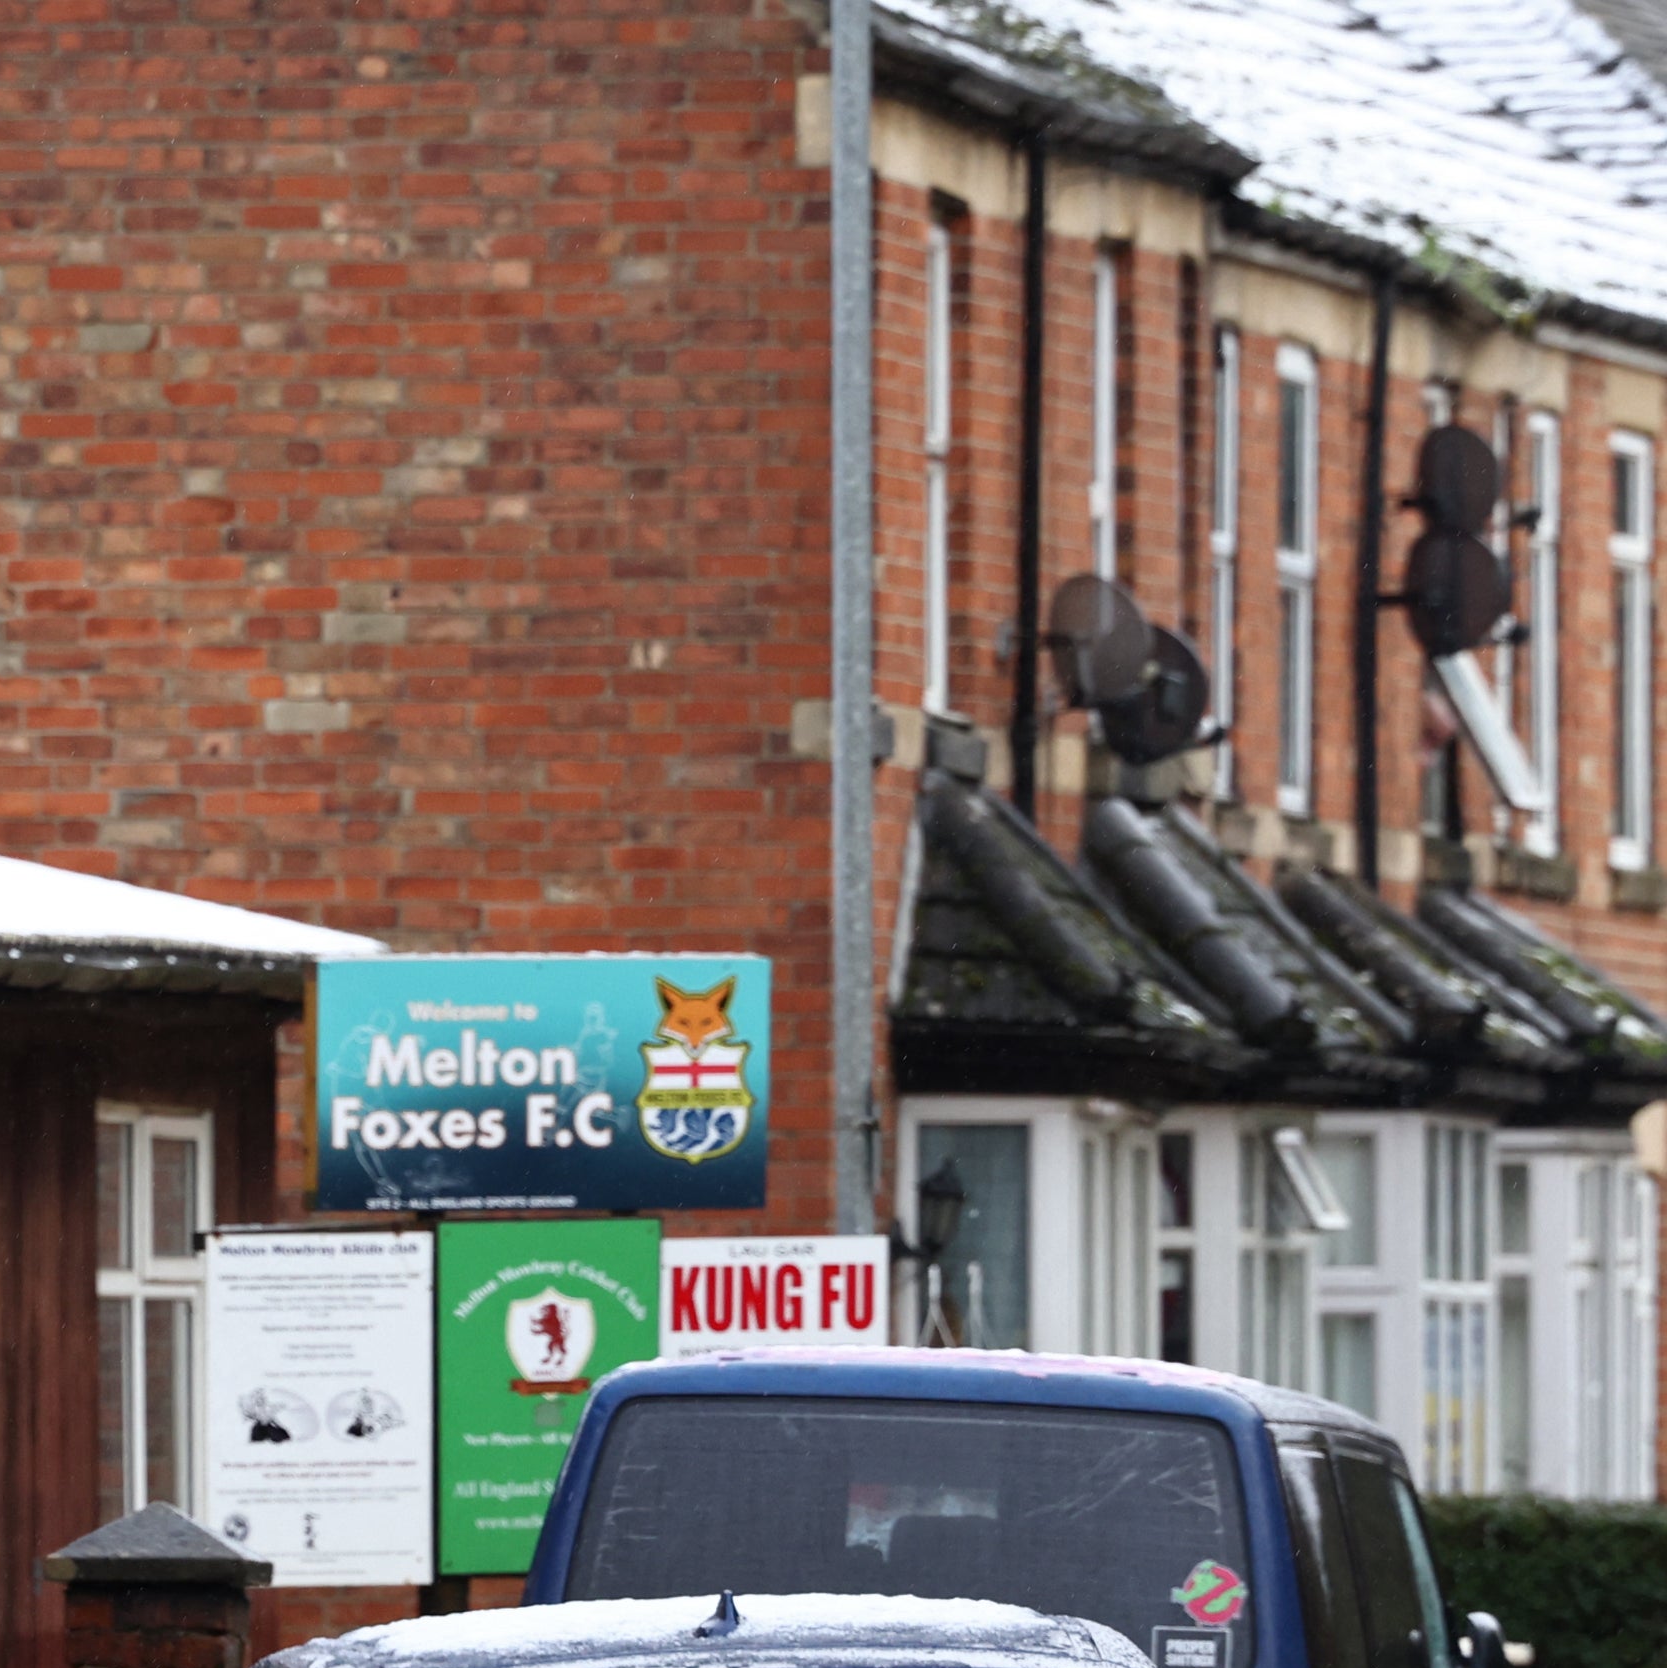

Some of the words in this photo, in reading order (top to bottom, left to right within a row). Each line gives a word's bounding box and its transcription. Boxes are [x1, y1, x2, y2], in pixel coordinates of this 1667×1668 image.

[407, 999, 509, 1022] Welcome
[514, 1002, 539, 1022] to
[365, 1029, 578, 1087] Melton
[331, 1095, 507, 1149] Foxes
[525, 1091, 613, 1148] F.C
[453, 1278, 498, 1322] Melton
[496, 1259, 566, 1283] Mowbray
[567, 1260, 620, 1294] Cricket
[616, 1286, 647, 1322] Club
[671, 1263, 804, 1332] KUNG
[820, 1263, 875, 1330] FU
[479, 1480, 540, 1501] England
[1165, 1639, 1216, 1654] PROPER
